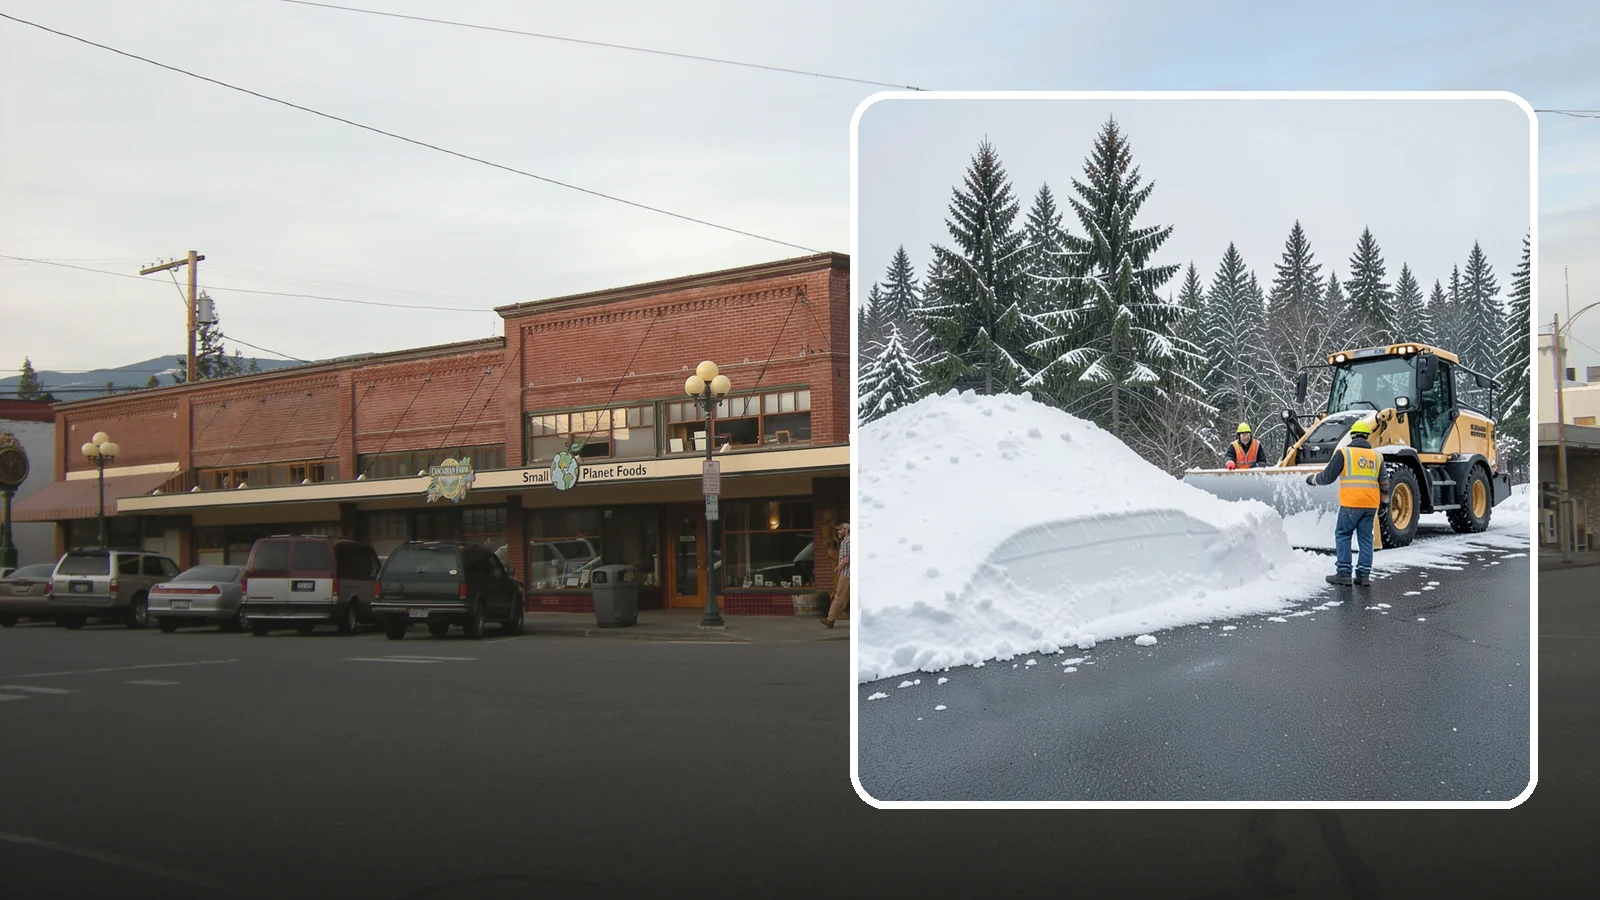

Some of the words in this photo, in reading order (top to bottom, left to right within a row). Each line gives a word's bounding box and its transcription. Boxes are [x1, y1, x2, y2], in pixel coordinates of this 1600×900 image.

[523, 470, 549, 483] Small
[583, 467, 614, 480] Planet
[617, 464, 647, 477] Foods
